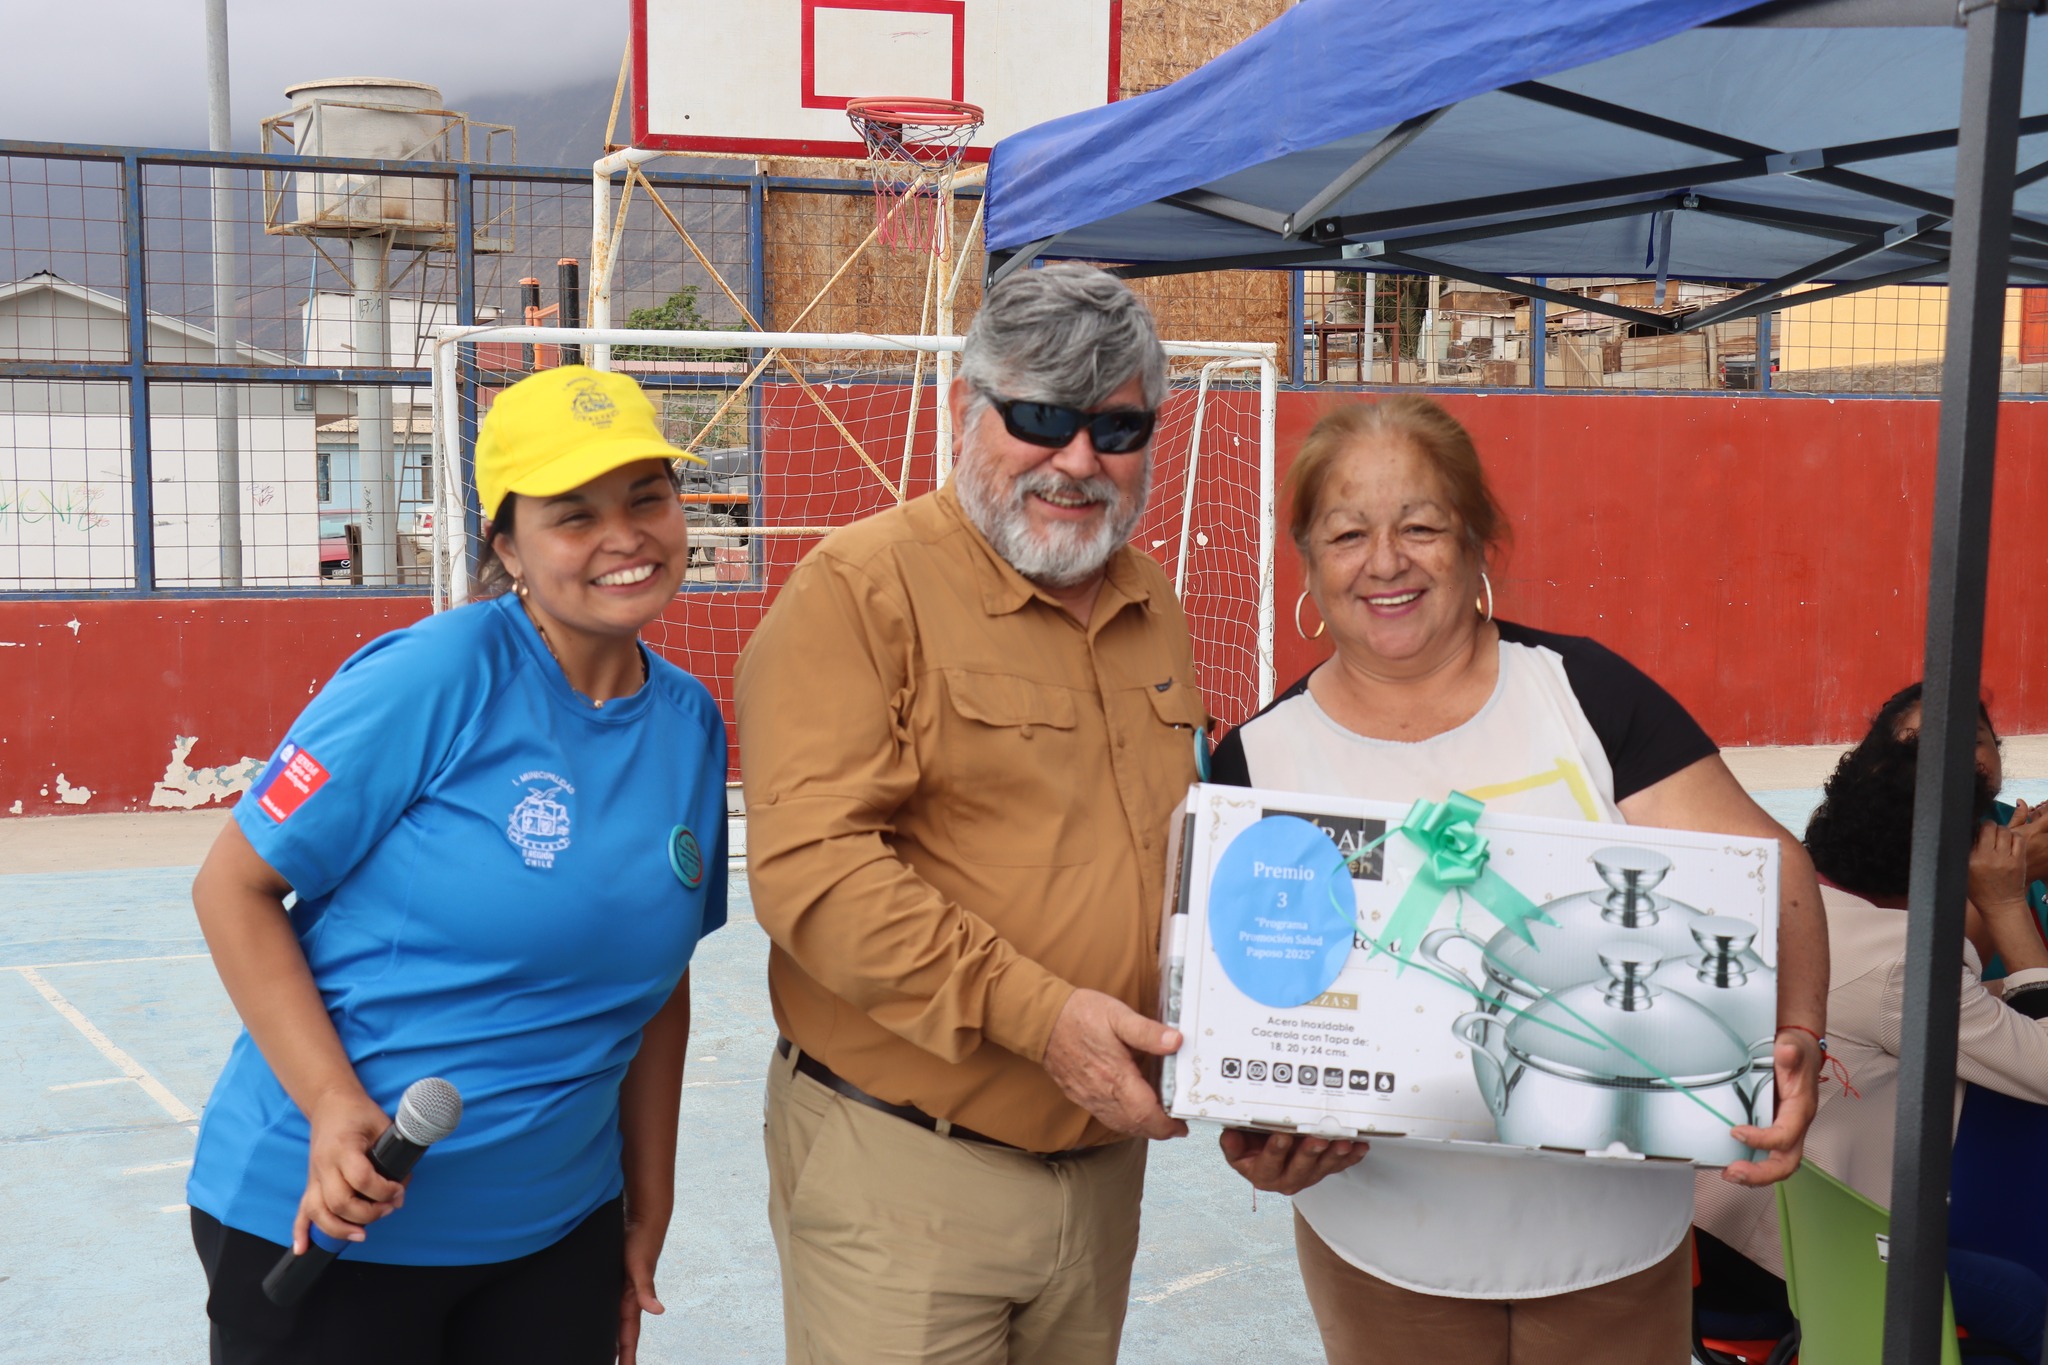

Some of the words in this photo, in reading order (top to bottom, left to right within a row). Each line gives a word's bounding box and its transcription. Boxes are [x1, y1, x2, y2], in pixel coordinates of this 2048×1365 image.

[1253, 861, 1315, 881] Premio
[1276, 891, 1288, 908] 3
[1239, 931, 1294, 945] Promoción
[1295, 934, 1323, 947] Salud
[1246, 946, 1283, 960] Paposo
[1267, 1016, 1298, 1028] Acero
[1301, 1019, 1355, 1033] Inoxidable
[1251, 1027, 1300, 1040] Cacerola
[1302, 1033, 1322, 1042] con
[1324, 1034, 1350, 1046] Tapa
[1352, 1036, 1370, 1047] de:
[1287, 1043, 1299, 1053] 20
[1301, 1046, 1308, 1055] y
[1310, 1046, 1323, 1055] 24
[1325, 1048, 1350, 1058] cms.
